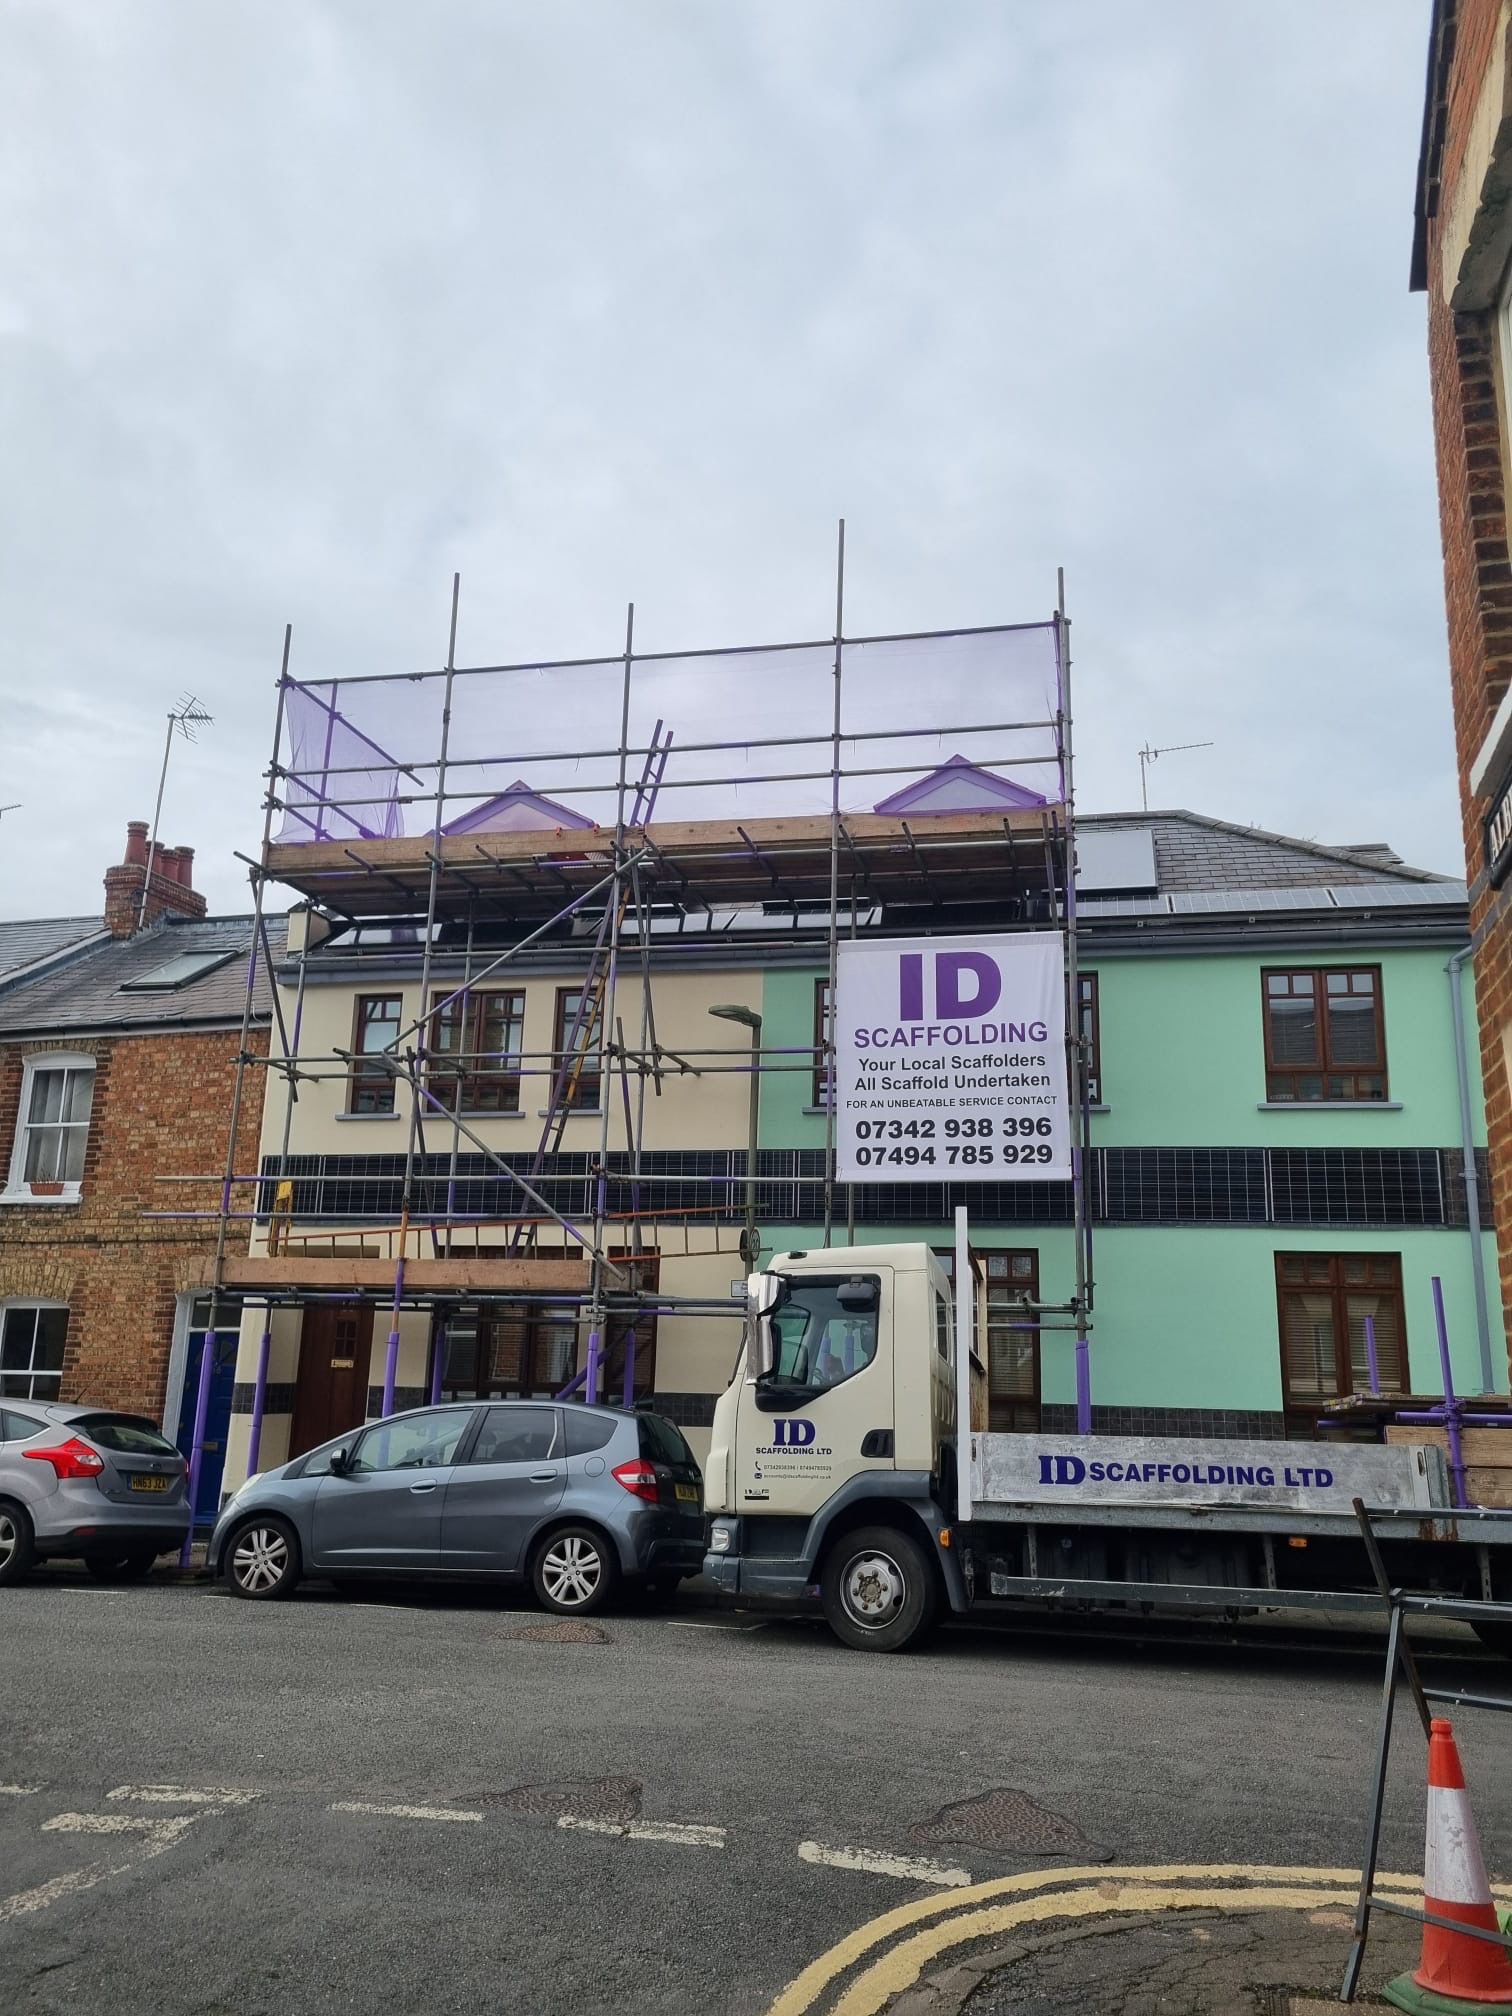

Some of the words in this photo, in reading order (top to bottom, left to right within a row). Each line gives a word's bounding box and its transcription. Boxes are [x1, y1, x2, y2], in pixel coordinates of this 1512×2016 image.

[1489, 786, 1512, 866] ALB
[900, 952, 1002, 1021] ID
[854, 1022, 1048, 1048] SCAFFOLDING
[859, 1058, 895, 1071] Your
[901, 1057, 945, 1070] Local
[951, 1054, 1045, 1068] Scaffolders
[855, 1078, 875, 1090] All
[882, 1076, 948, 1090] Scaffold
[955, 1073, 1050, 1088] Undertaken
[870, 1100, 883, 1108] AN
[887, 1098, 955, 1108] UNBEATABLE
[959, 1097, 1003, 1106] SERVICE
[1007, 1096, 1057, 1105] CONTACT
[856, 1120, 935, 1139] 07342
[944, 1118, 993, 1137] 938
[1003, 1117, 1051, 1137] 396
[856, 1146, 936, 1165] 07494
[946, 1146, 993, 1164] 785
[1003, 1144, 1052, 1163] 929
[773, 1419, 815, 1446] ID
[1039, 1456, 1085, 1485] ID
[1090, 1462, 1274, 1486] SCAFFOLDING
[1285, 1467, 1333, 1487] LTD
